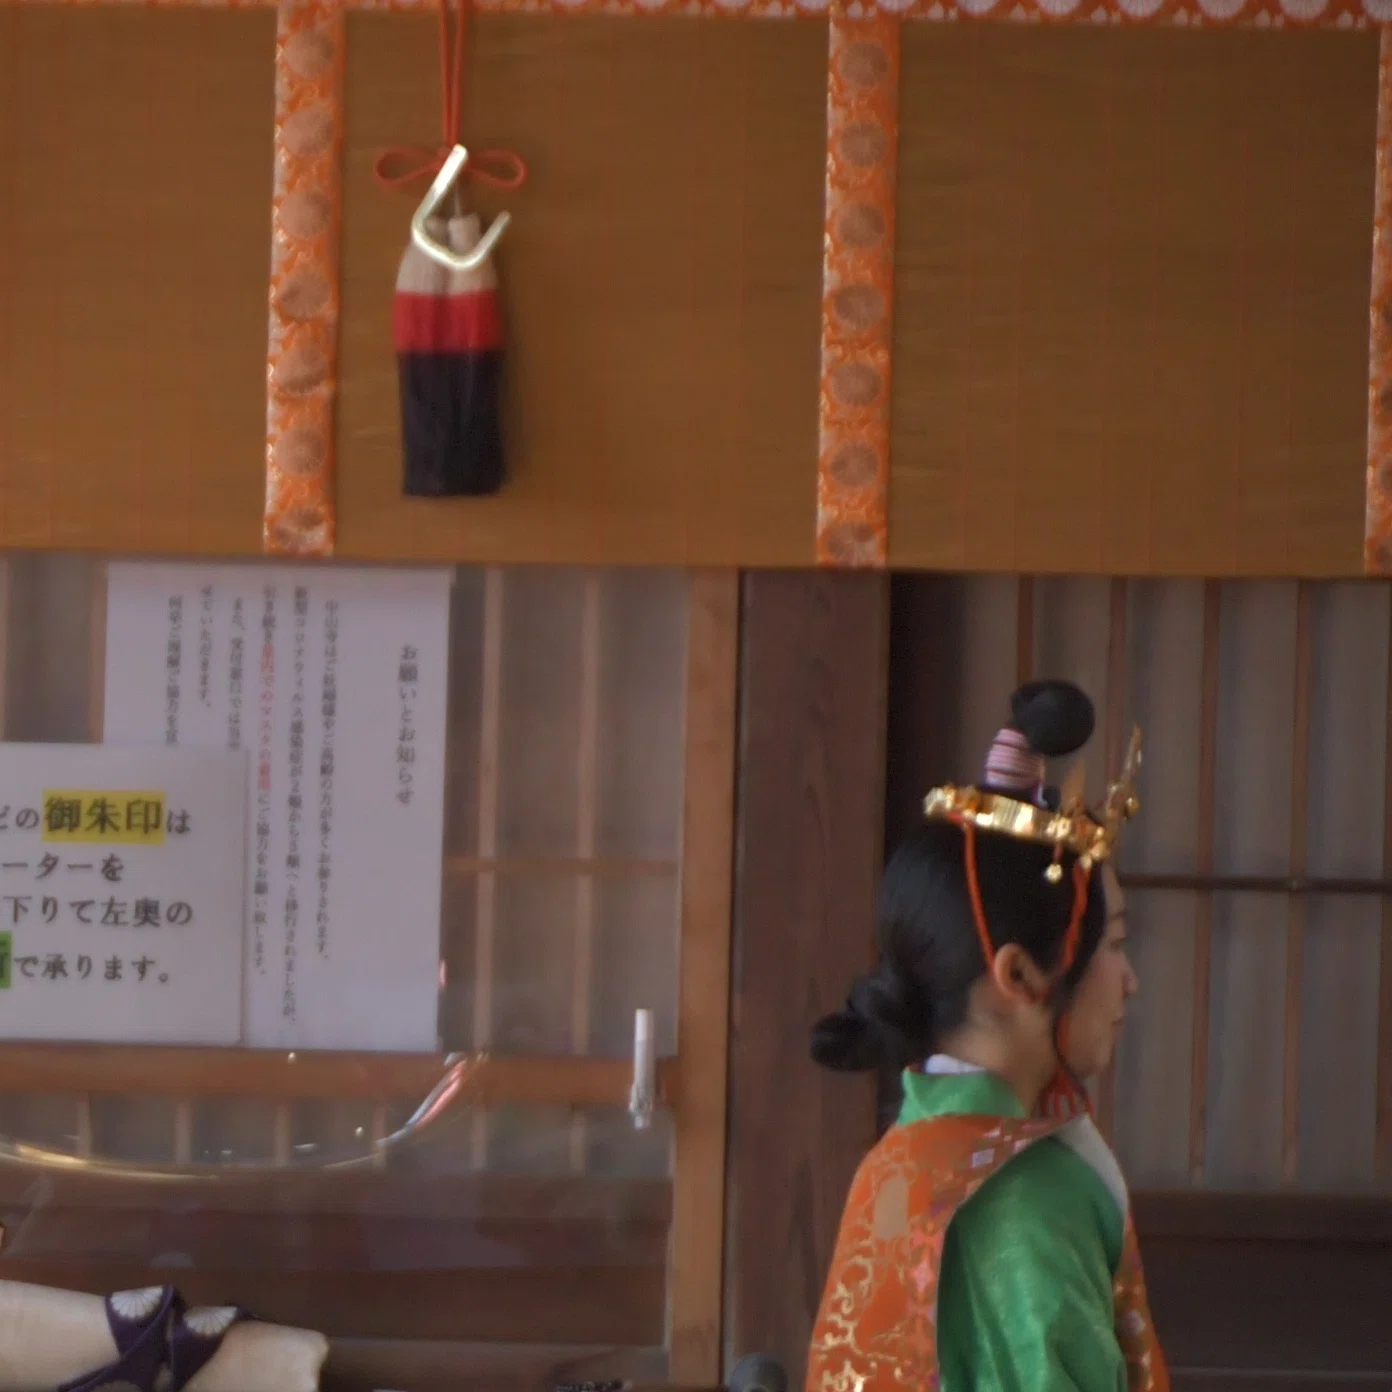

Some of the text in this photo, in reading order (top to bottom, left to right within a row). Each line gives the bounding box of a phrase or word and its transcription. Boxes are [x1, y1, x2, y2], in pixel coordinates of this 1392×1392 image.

[396, 644, 419, 805] お願いとお知らせ
